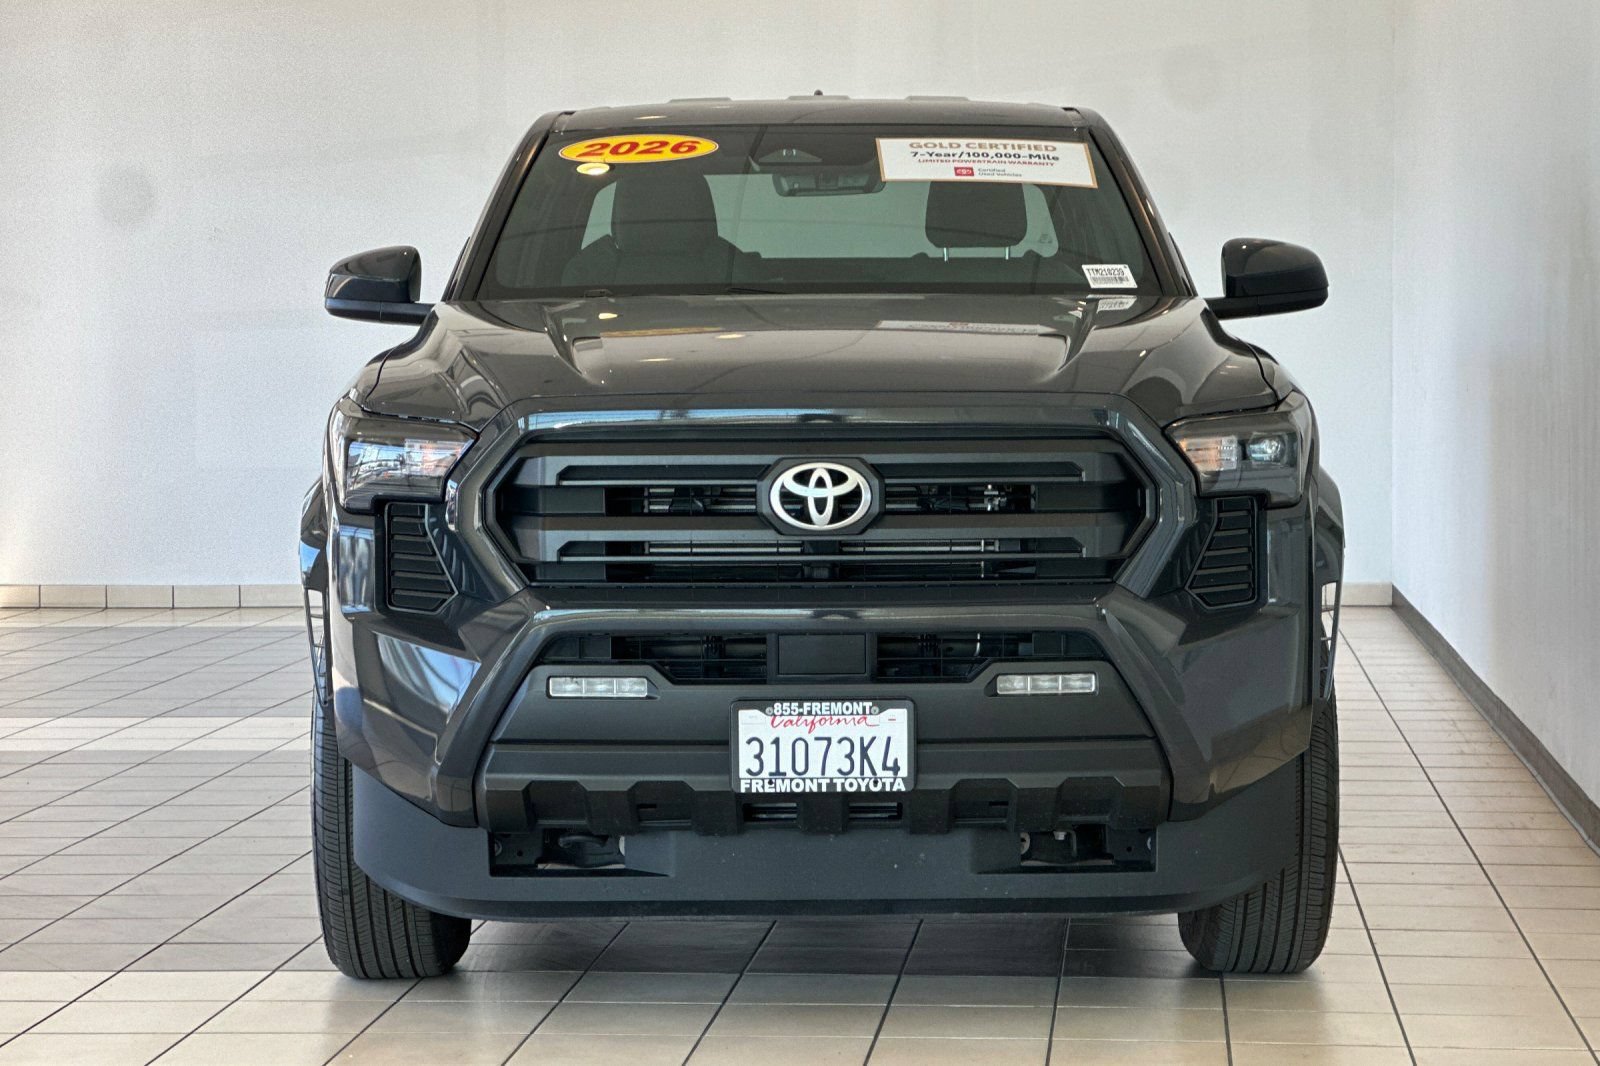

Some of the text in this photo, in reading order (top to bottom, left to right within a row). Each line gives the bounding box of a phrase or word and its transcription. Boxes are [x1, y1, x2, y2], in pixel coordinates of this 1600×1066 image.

[576, 140, 701, 158] 2026
[965, 143, 1057, 152] CERTIFIED
[910, 151, 1060, 161] 7-Year/100,000-Mile
[773, 702, 873, 716] 855-FREMONT
[770, 715, 880, 734] California
[745, 736, 900, 777] 31073K4
[740, 778, 906, 793] FREMONT TOYOTA
